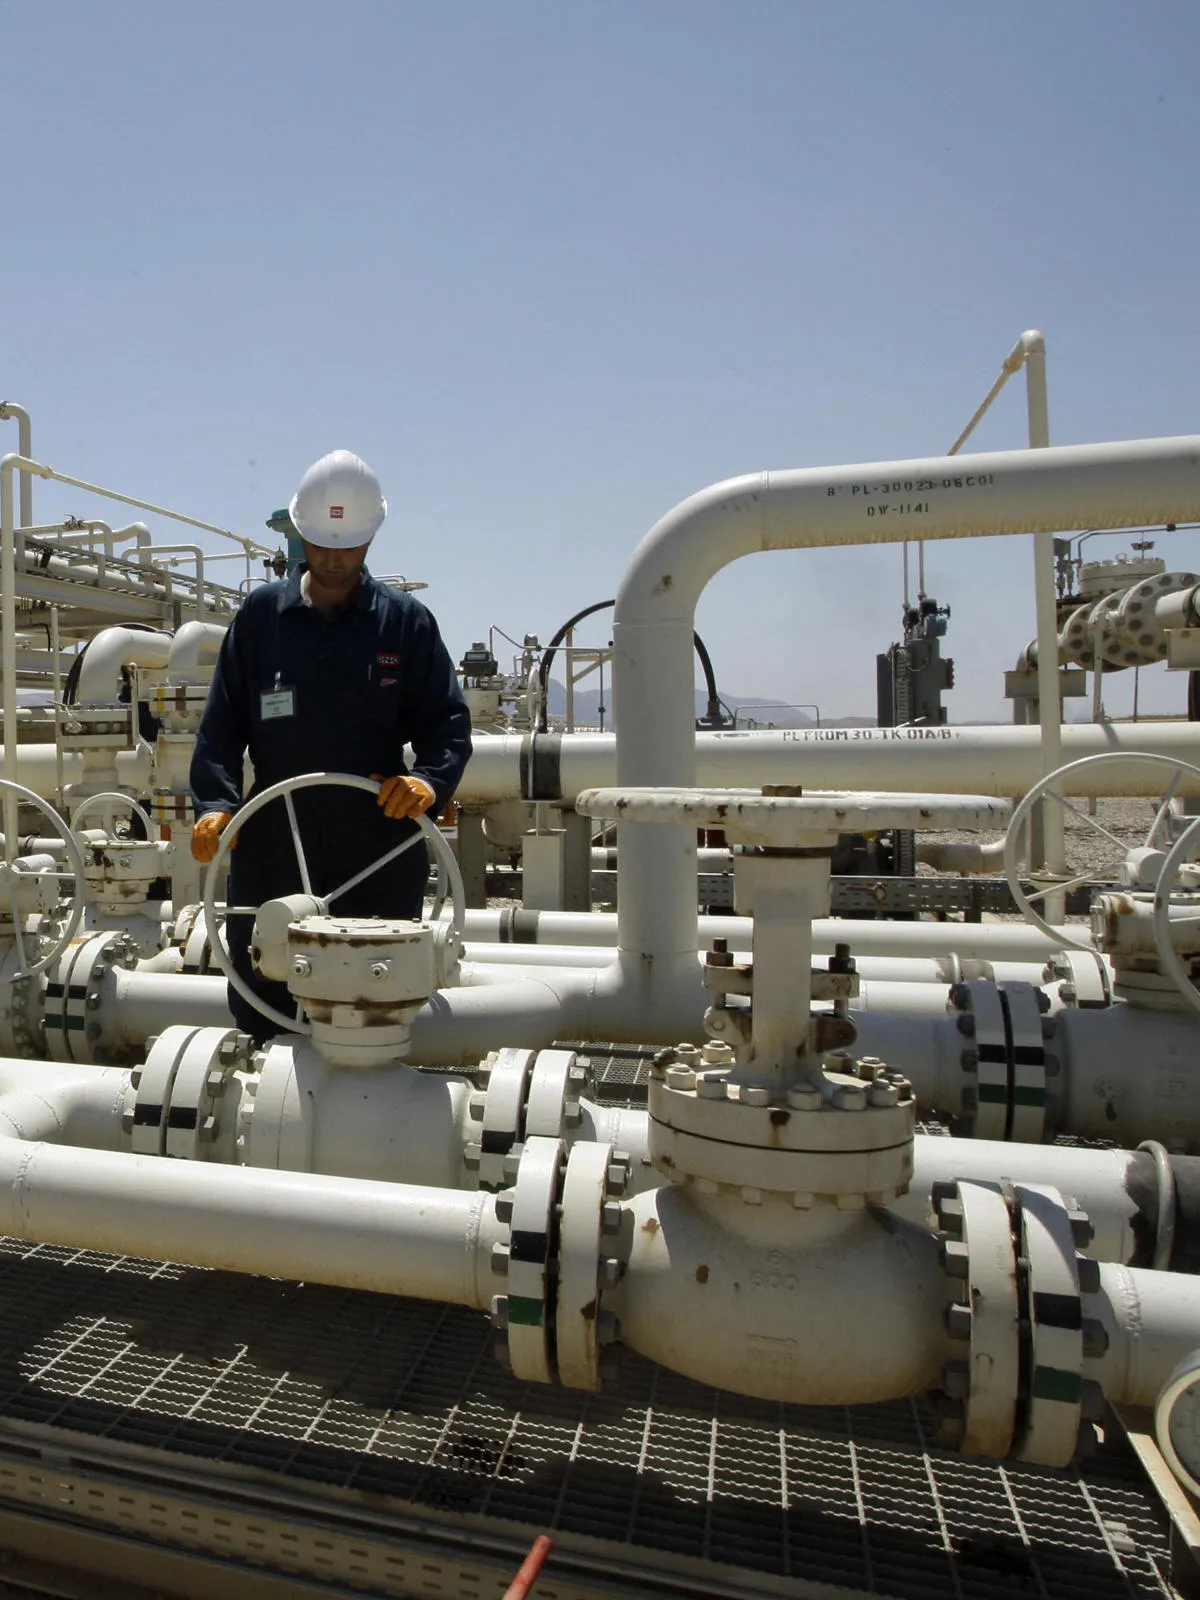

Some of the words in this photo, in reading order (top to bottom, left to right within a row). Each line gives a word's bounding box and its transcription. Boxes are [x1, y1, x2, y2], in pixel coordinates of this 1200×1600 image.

[867, 503, 930, 517] DW-1141
[782, 731, 801, 742] PL
[803, 730, 848, 741] FROM
